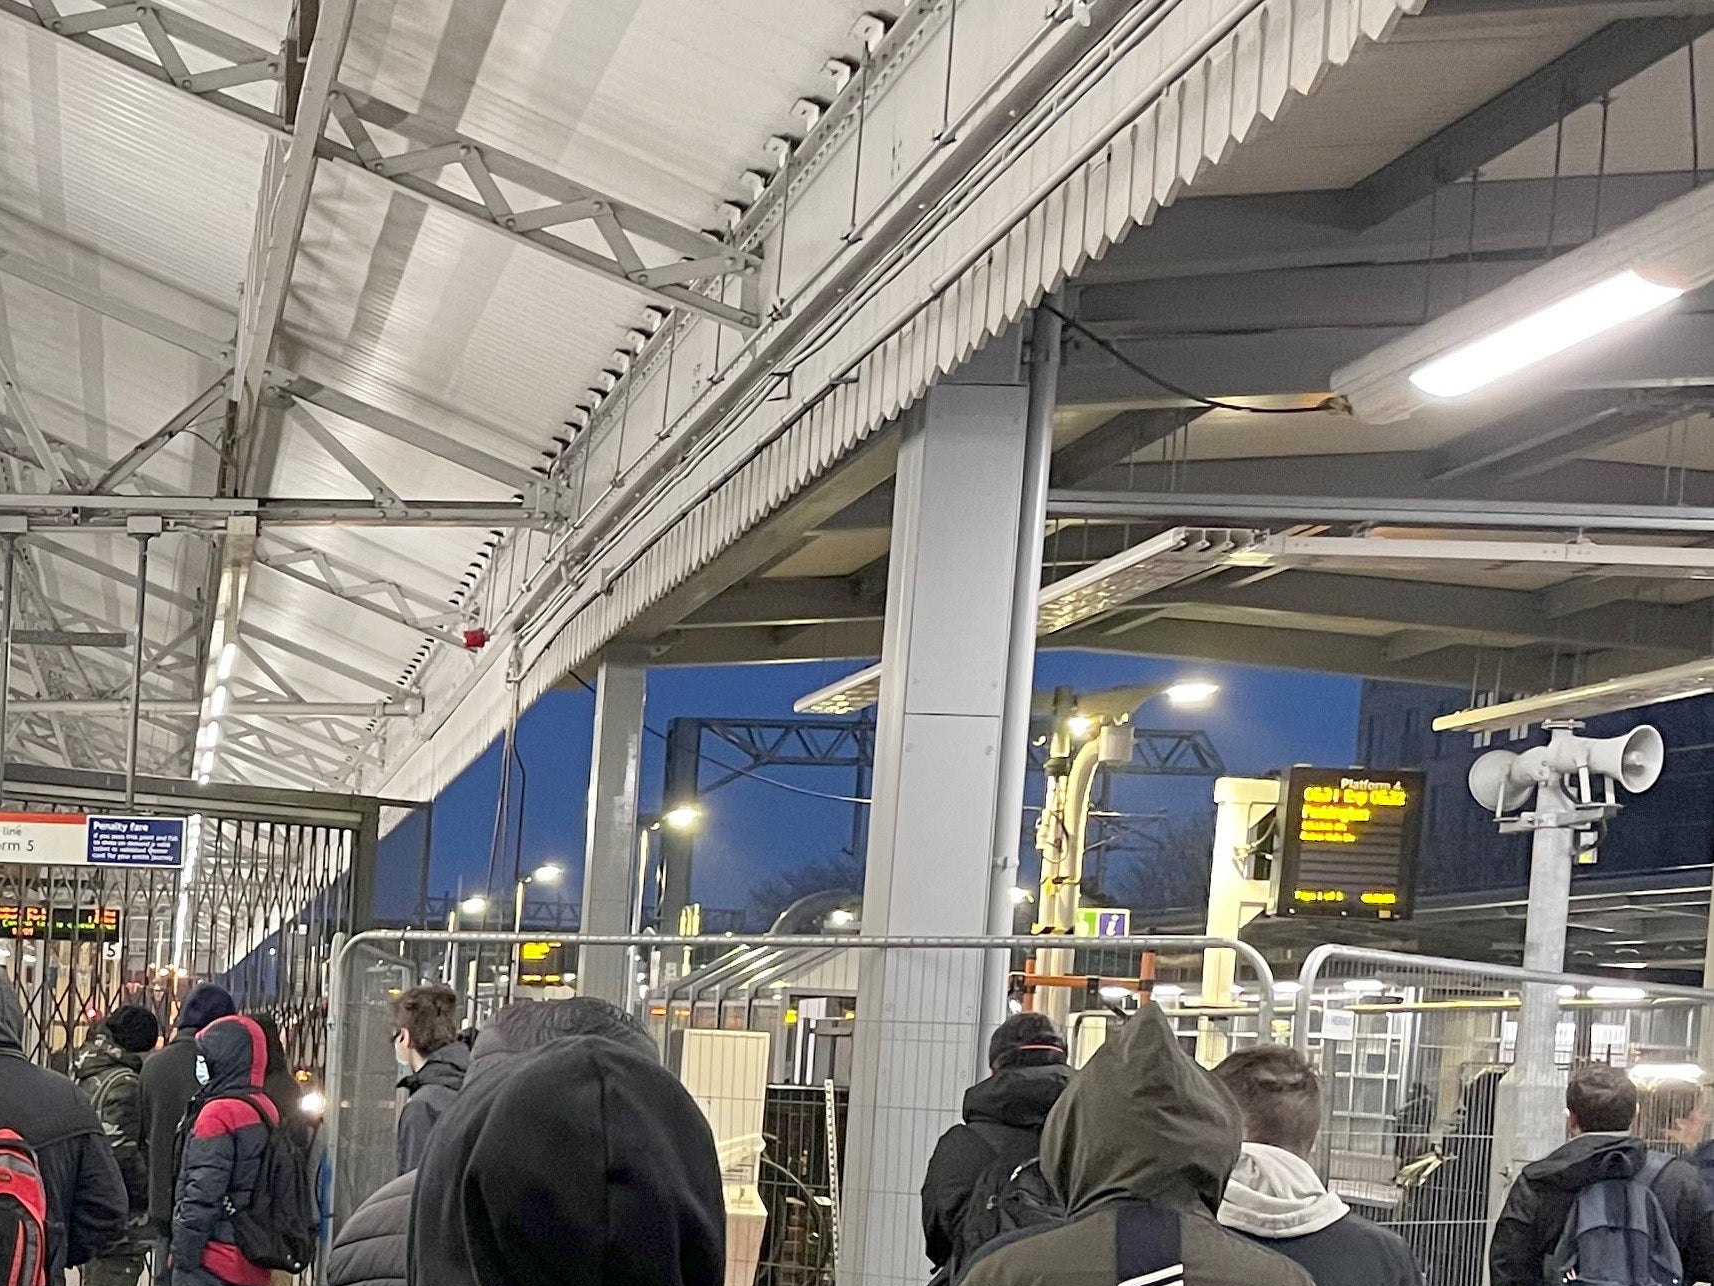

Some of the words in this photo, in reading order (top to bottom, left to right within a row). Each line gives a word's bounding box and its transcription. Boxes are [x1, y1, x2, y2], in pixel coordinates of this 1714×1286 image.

[1340, 777, 1391, 790] Platform
[2, 825, 23, 837] line
[93, 820, 128, 833] Penalty
[129, 821, 149, 832] fare
[27, 839, 35, 852] 5
[106, 944, 116, 958] 5
